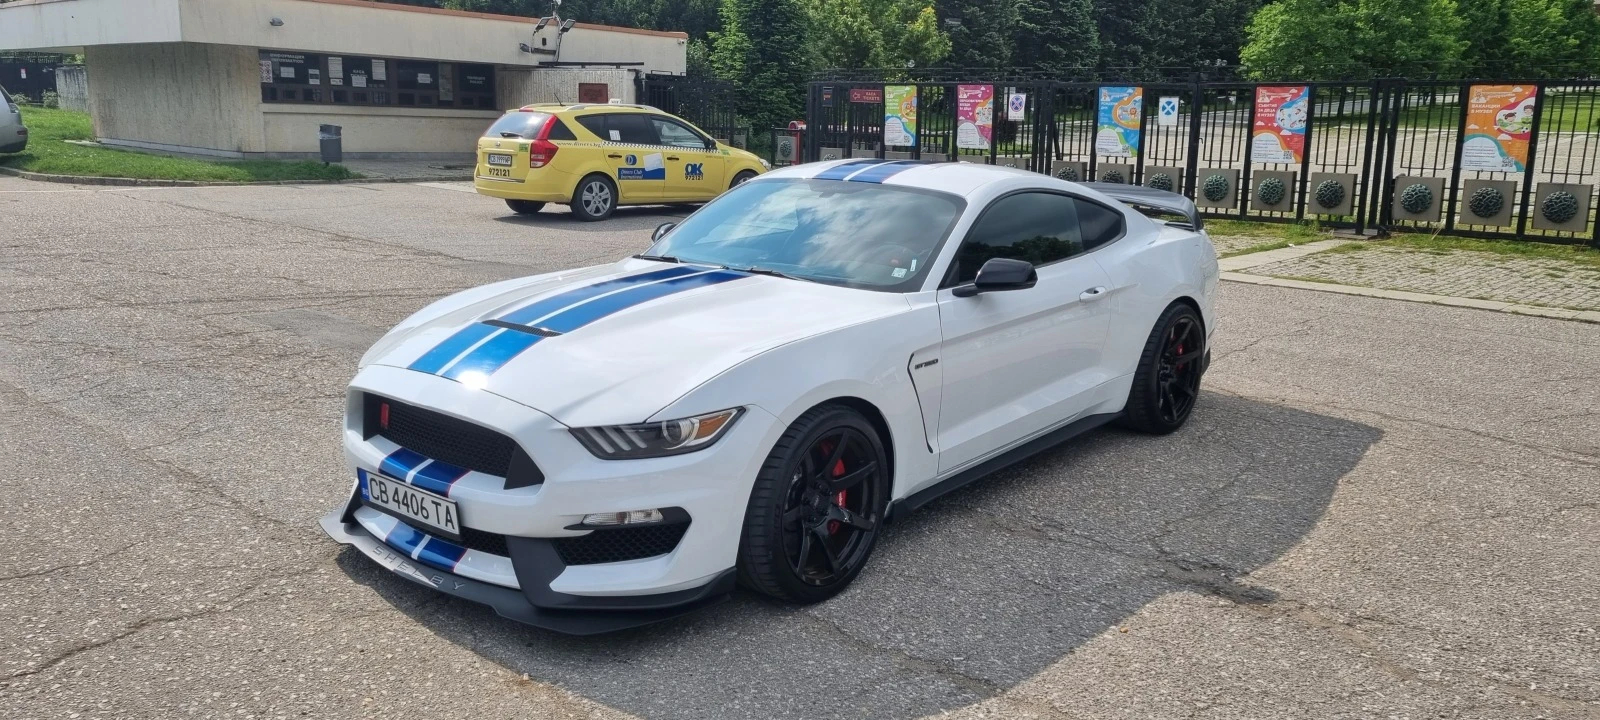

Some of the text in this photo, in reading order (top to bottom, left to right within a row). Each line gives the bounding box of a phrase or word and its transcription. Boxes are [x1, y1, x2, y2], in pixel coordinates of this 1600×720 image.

[489, 168, 510, 177] 972121
[685, 163, 704, 175] OK
[369, 478, 455, 530] CB 4406 TA
[373, 546, 465, 590] SHELBY
